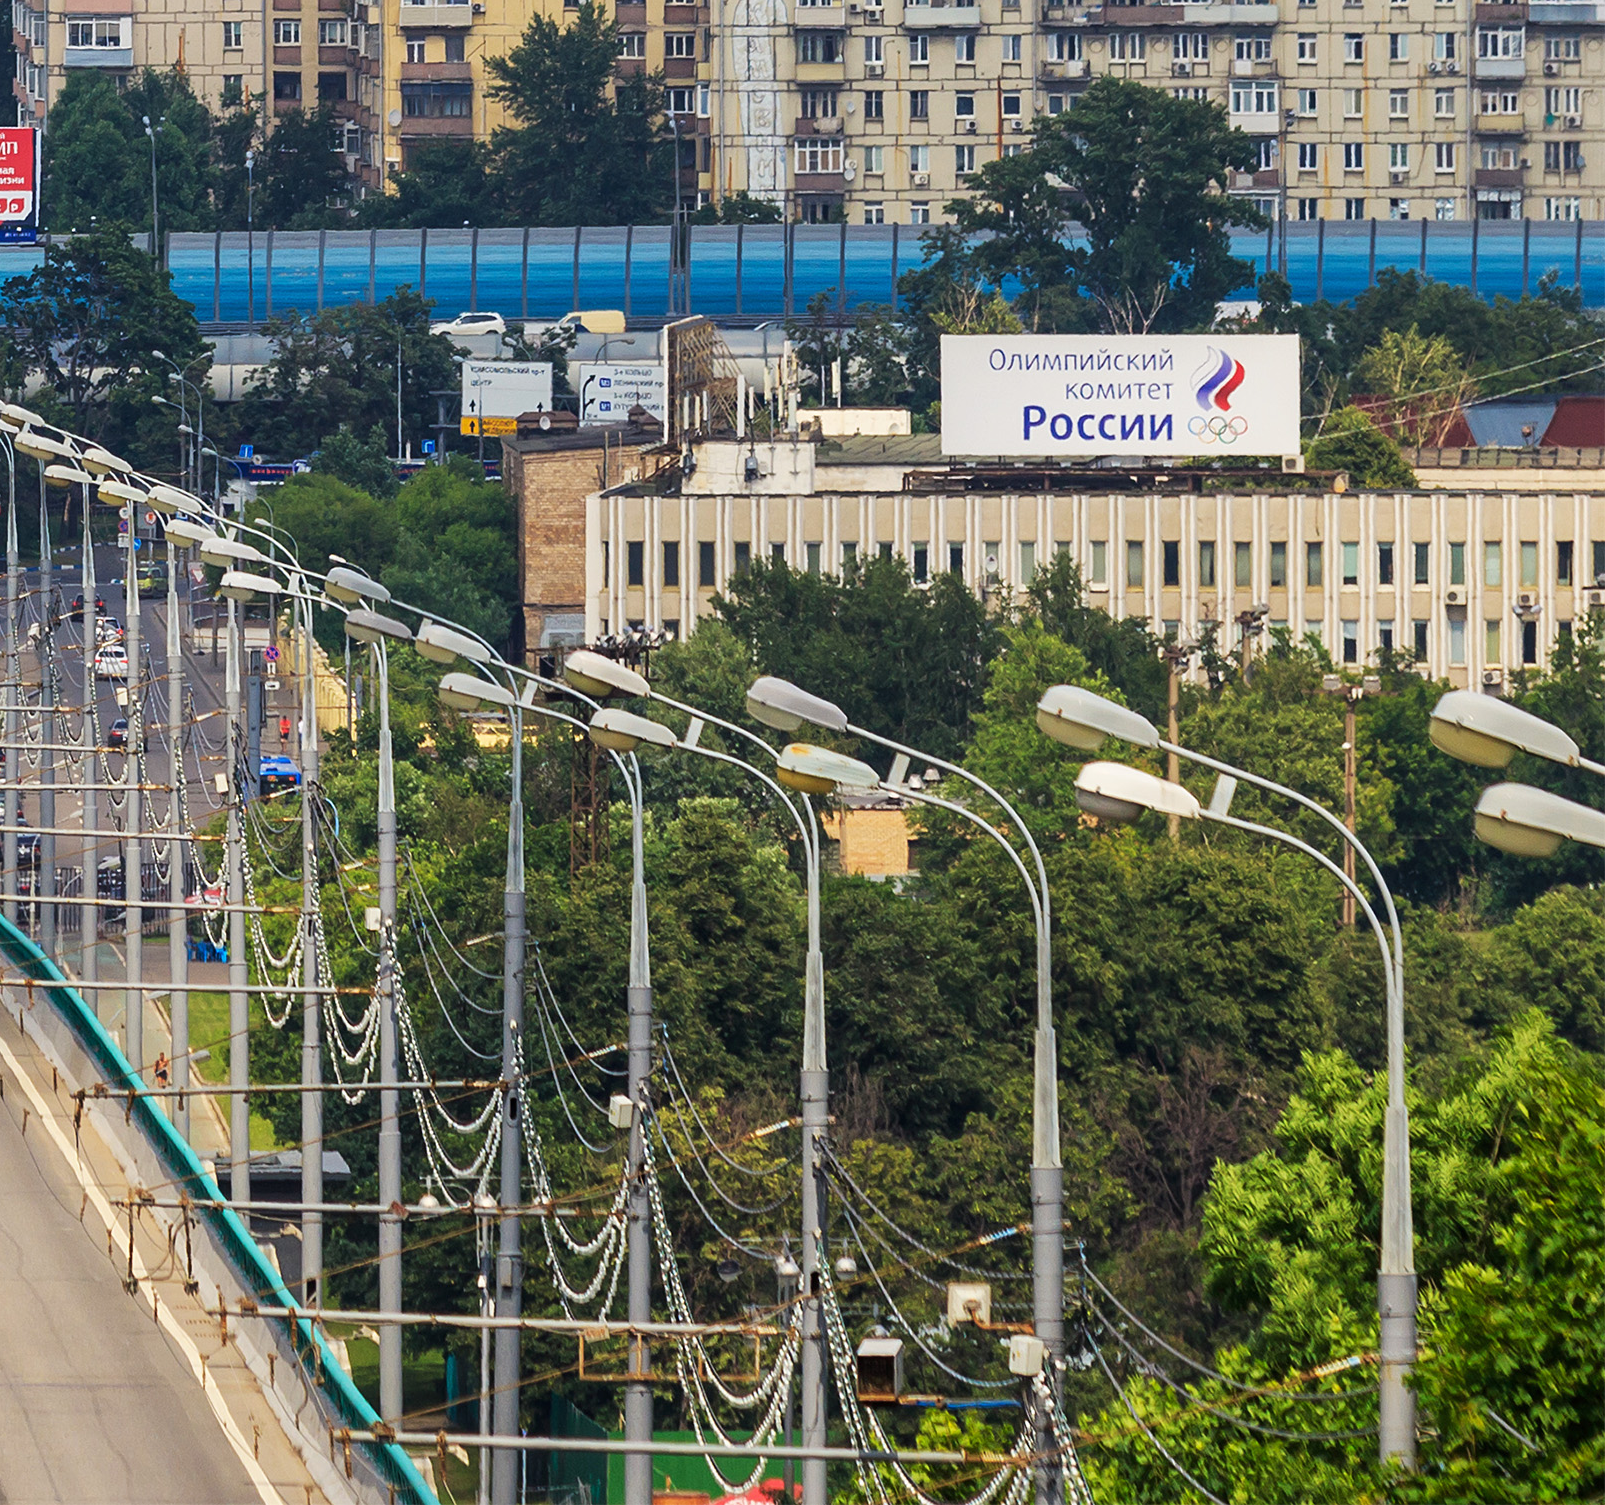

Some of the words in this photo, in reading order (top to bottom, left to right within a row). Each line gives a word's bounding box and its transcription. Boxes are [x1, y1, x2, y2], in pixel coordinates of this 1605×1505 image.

[989, 348, 1174, 371] Олимпийский
[470, 366, 530, 374] КОМСОМОЛЬСКИЙ
[1065, 382, 1175, 400] комитет
[1023, 405, 1173, 441] России
